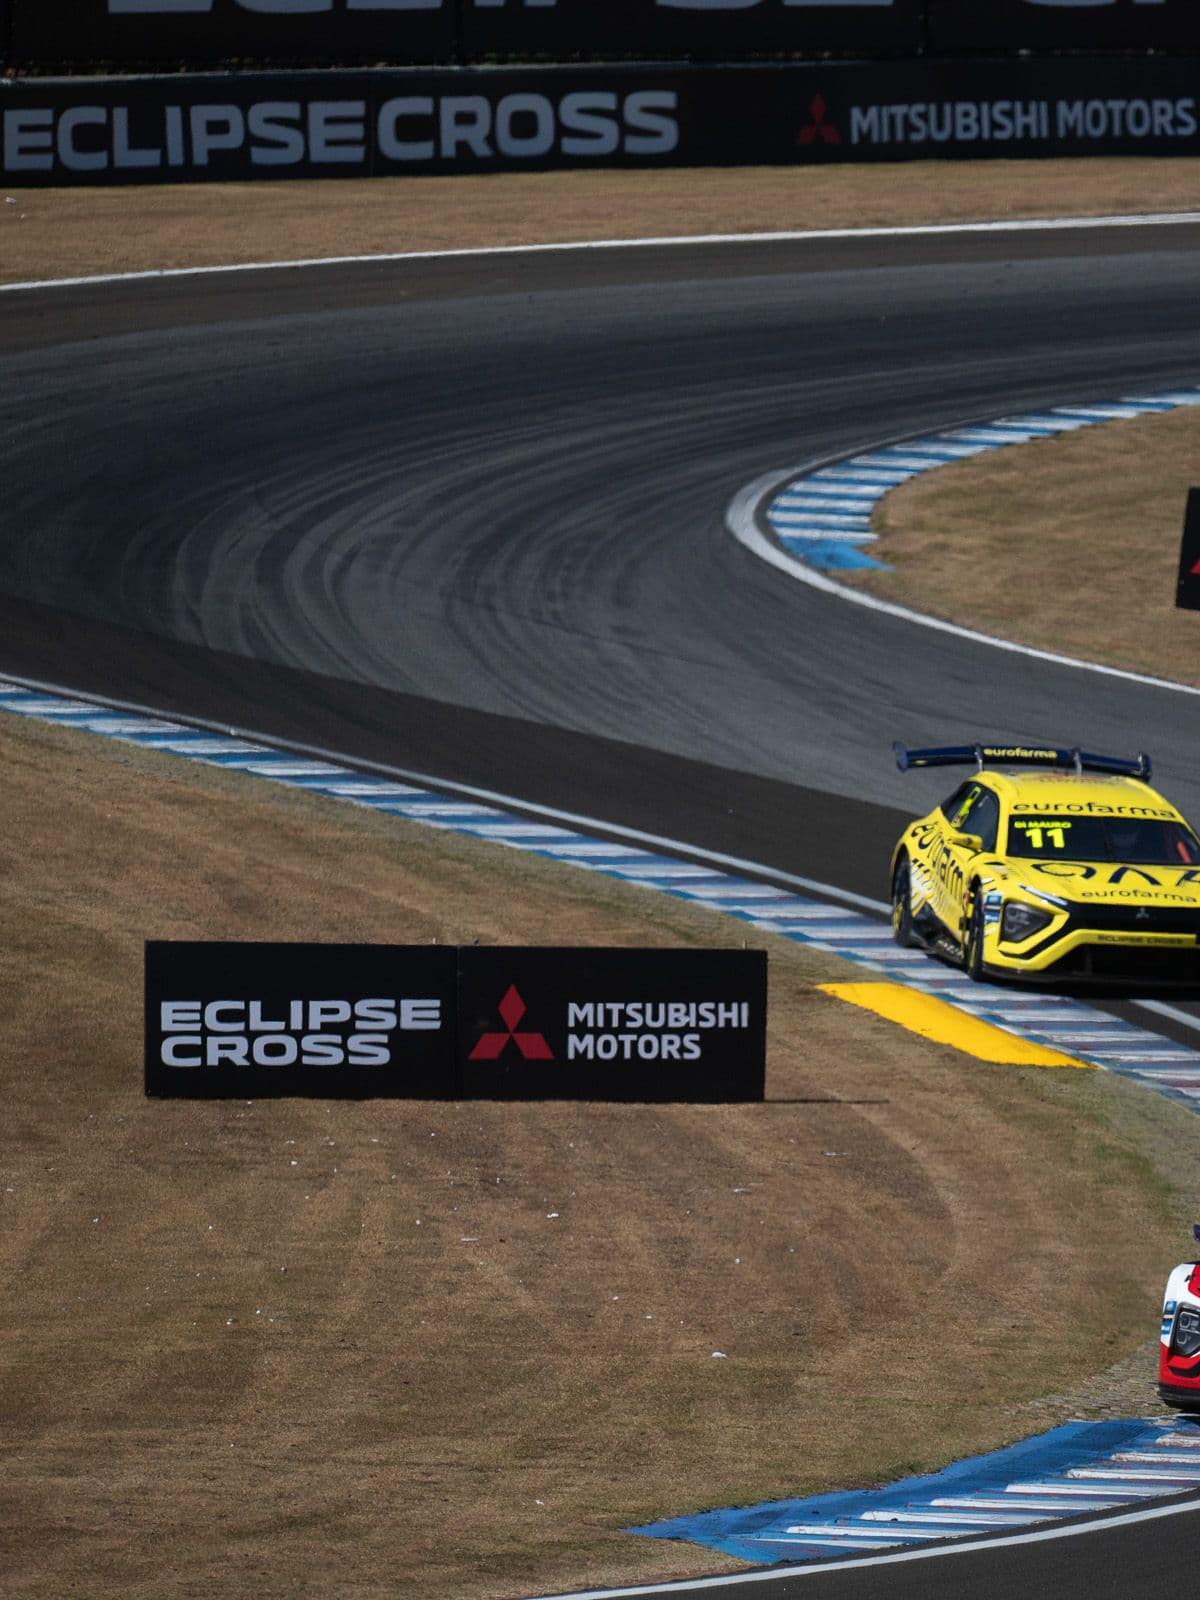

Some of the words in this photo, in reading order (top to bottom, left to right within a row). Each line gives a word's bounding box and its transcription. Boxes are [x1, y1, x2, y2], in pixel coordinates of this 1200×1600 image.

[3, 100, 367, 171] ECLIPSE
[377, 90, 680, 161] CROSS
[851, 101, 1048, 144] MITSUBISHI
[1056, 98, 1198, 138] MOTORS
[983, 747, 1057, 759] eurofarma
[1013, 802, 1176, 819] eurofarma
[1025, 828, 1066, 849] 11
[1081, 888, 1198, 903] eurofarma
[161, 999, 442, 1033] ECLIPSE
[567, 1001, 749, 1030] MITSUBISHI
[161, 1033, 391, 1068] CROSS
[567, 1032, 702, 1061] MOTORS
